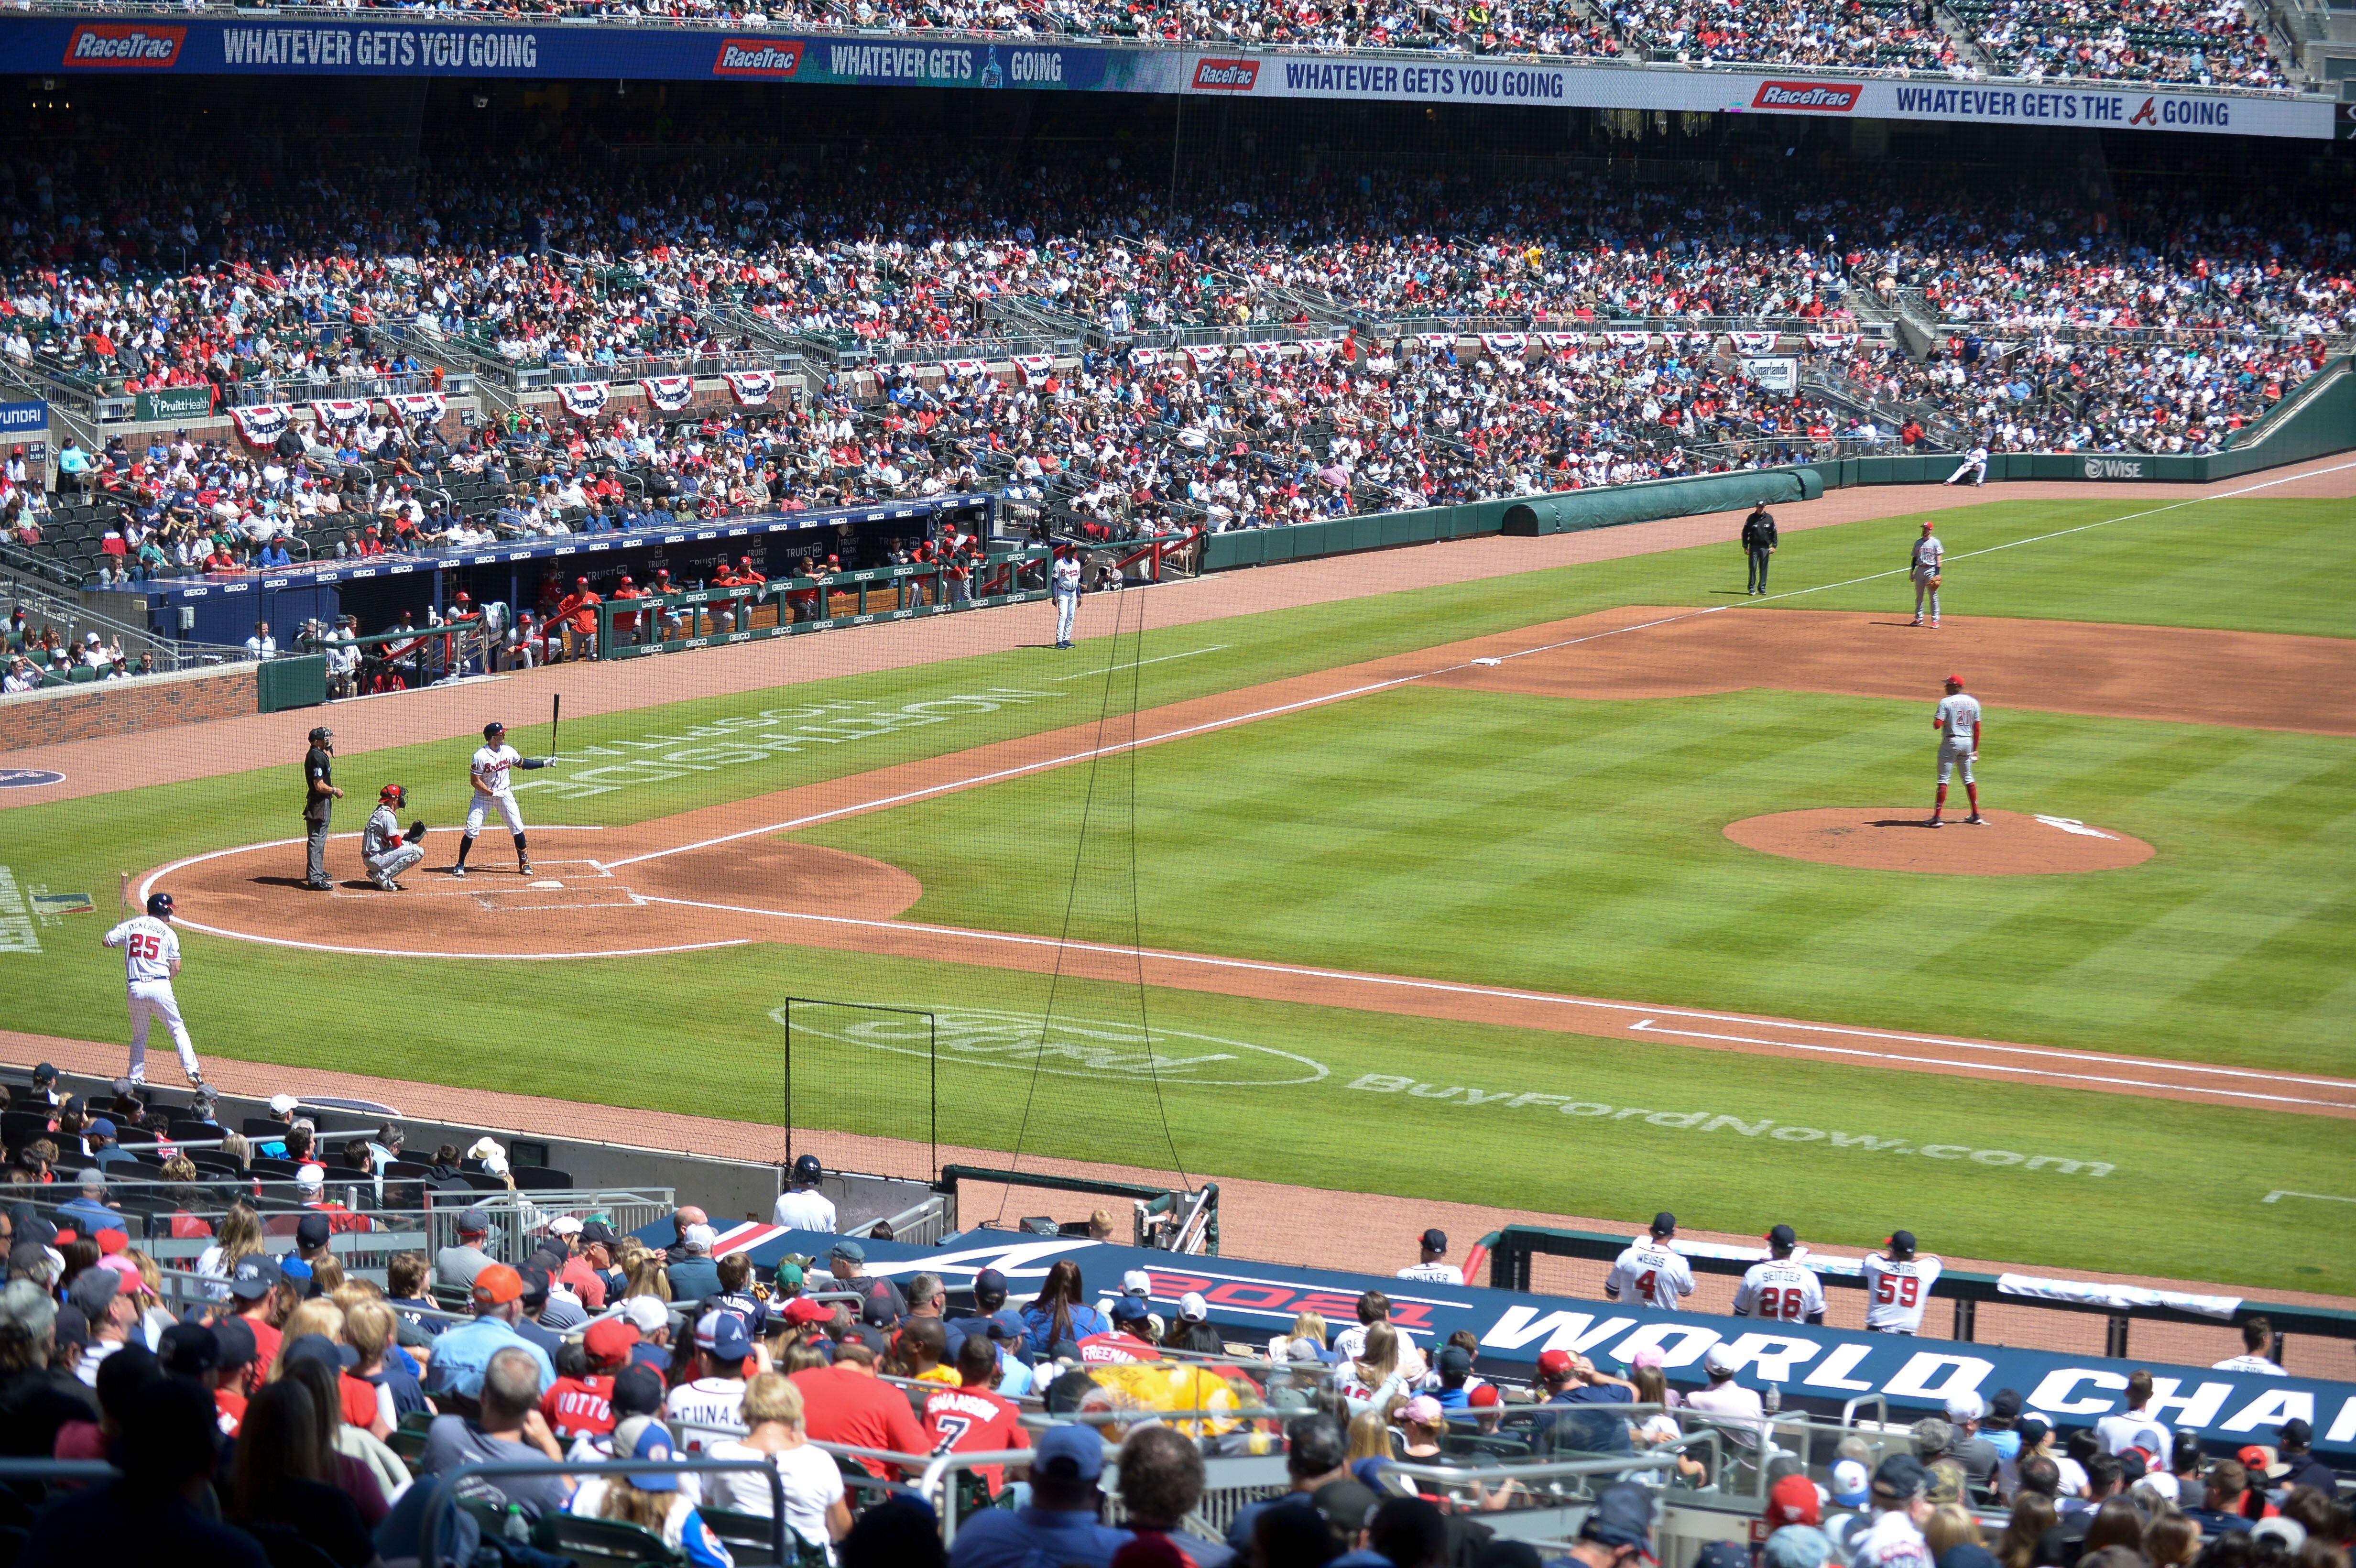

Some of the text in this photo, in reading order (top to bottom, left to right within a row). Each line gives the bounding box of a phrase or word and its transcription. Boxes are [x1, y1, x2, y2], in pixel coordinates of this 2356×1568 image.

[76, 32, 174, 58] RaceTrac
[223, 29, 536, 68] WHATEVER GETS YOU GOING
[722, 46, 794, 68] RaceTrac
[831, 45, 971, 79] WHATEVER GETS
[1011, 51, 1062, 82] GOING
[1198, 64, 1253, 85] RaceTrac
[1286, 63, 1563, 98] WHATEVER GETS YOU GOING
[1761, 86, 1851, 107] RaceTrac
[1897, 87, 2016, 116] WHATEVER
[2023, 93, 2077, 120] GETS
[2083, 96, 2122, 121] THE
[2162, 102, 2229, 126] GOING
[1113, 307, 1124, 316] 44
[161, 396, 209, 412] PruittHealth
[2104, 460, 2143, 478] WISE
[729, 527, 748, 535] GEICO
[622, 539, 643, 547] GEICO
[665, 535, 684, 543] GEICO
[589, 543, 609, 551] GEICO
[510, 551, 531, 560] GEICO
[747, 548, 767, 556] TRUIST
[786, 547, 811, 558] TRUIST
[475, 555, 495, 564] GEICO
[1007, 553, 1025, 562] GEICO
[438, 559, 460, 568] GEICO
[648, 559, 669, 568] TRUIST
[353, 569, 376, 577] GEICO
[391, 565, 413, 573] GEICO
[894, 566, 913, 576] GEICO
[316, 573, 337, 582] GEICO
[854, 572, 874, 581] GEICO
[224, 583, 248, 592] GEICO
[264, 579, 287, 588] GEICO
[772, 582, 793, 591] GEICO
[184, 588, 207, 597] GEICO
[729, 588, 750, 597] GEICO
[686, 593, 708, 602] GEICO
[1006, 594, 1025, 602] GEICO
[641, 599, 664, 608] GEICO
[970, 599, 988, 607] GEICO
[933, 604, 951, 612] GEICO
[854, 614, 874, 623] GEICO
[893, 610, 913, 619] GEICO
[813, 620, 833, 629] GEICO
[771, 626, 792, 635] GEICO
[729, 632, 750, 642] GEICO
[686, 638, 707, 647] GEICO
[641, 644, 663, 653] GEICO
[1955, 710, 1972, 726] 21
[130, 933, 161, 960] 25
[1344, 1072, 2117, 1178] BuyFordNow.com
[1637, 1253, 1666, 1268] WEISS
[1763, 1271, 1801, 1282] SEITZER
[1635, 1269, 1657, 1300] 4
[1878, 1274, 1919, 1308] 59
[718, 1296, 755, 1315] ALDSON
[1759, 1287, 1802, 1318] 26
[1480, 1306, 1996, 1400] WORLD
[558, 1392, 611, 1422] VOTTO
[928, 1393, 1000, 1423] SWANSON
[932, 1414, 971, 1457] 7
